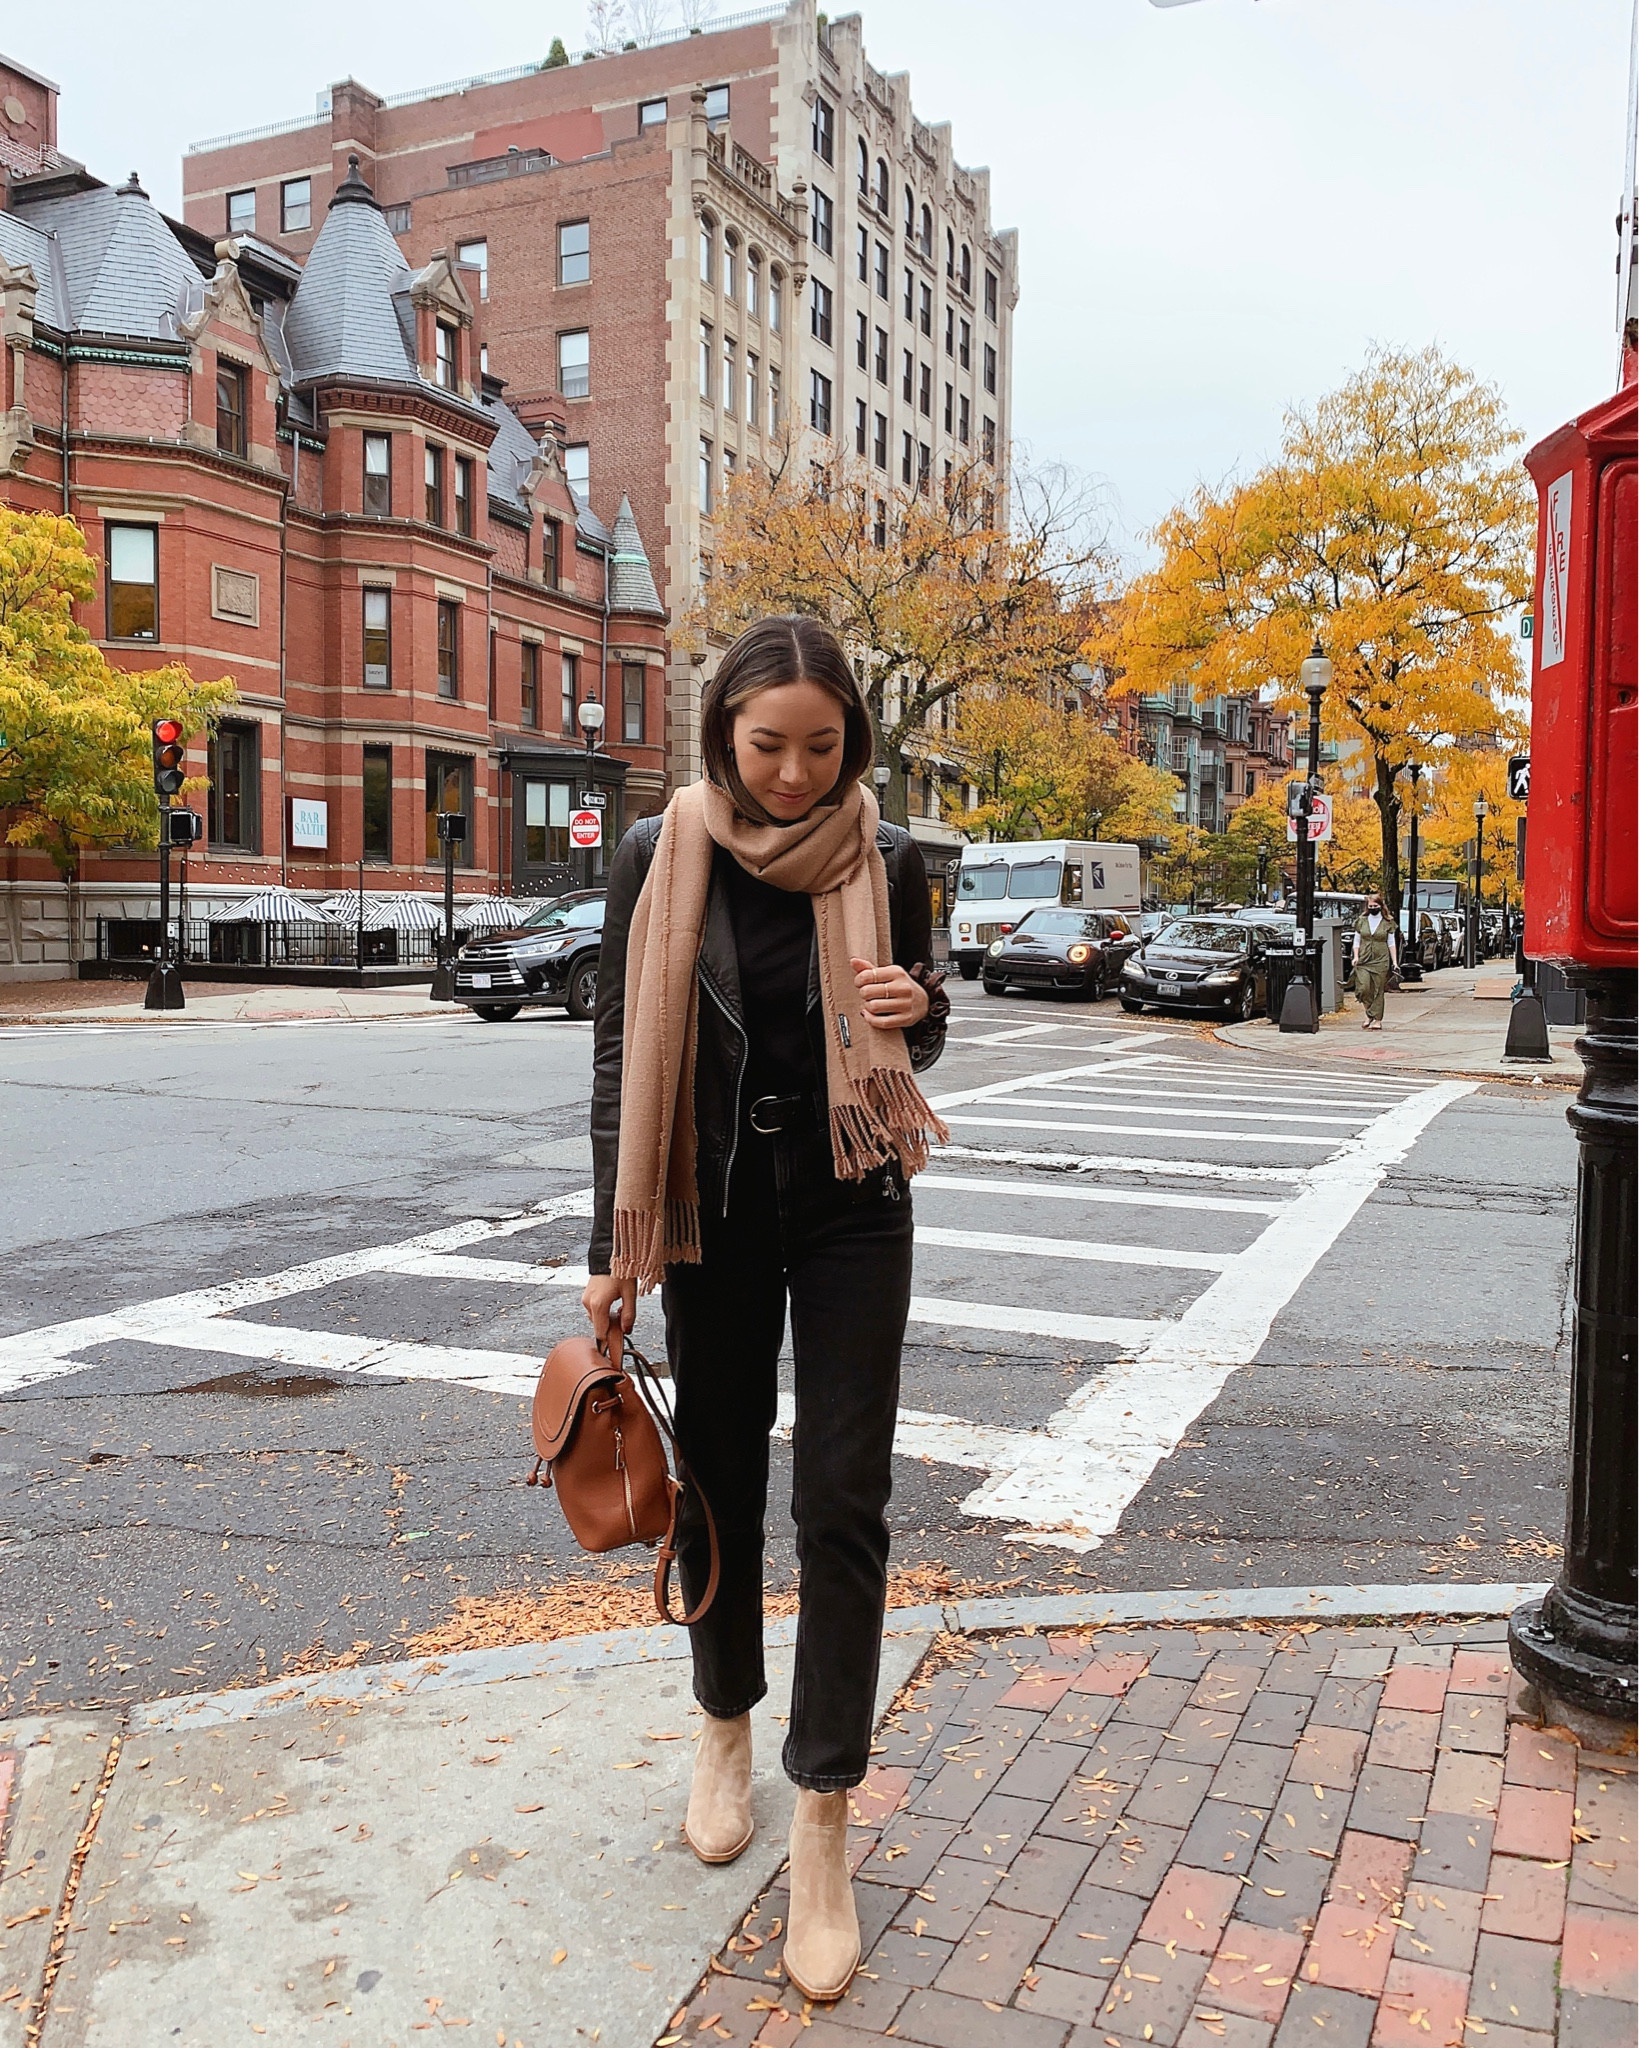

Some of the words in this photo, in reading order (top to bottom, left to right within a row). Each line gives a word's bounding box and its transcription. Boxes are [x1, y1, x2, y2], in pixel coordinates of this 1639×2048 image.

[1553, 490, 1566, 573] FIRE
[1548, 543, 1560, 655] EMERGENCY
[294, 822, 326, 836] SALTIE
[300, 810, 319, 823] BAR
